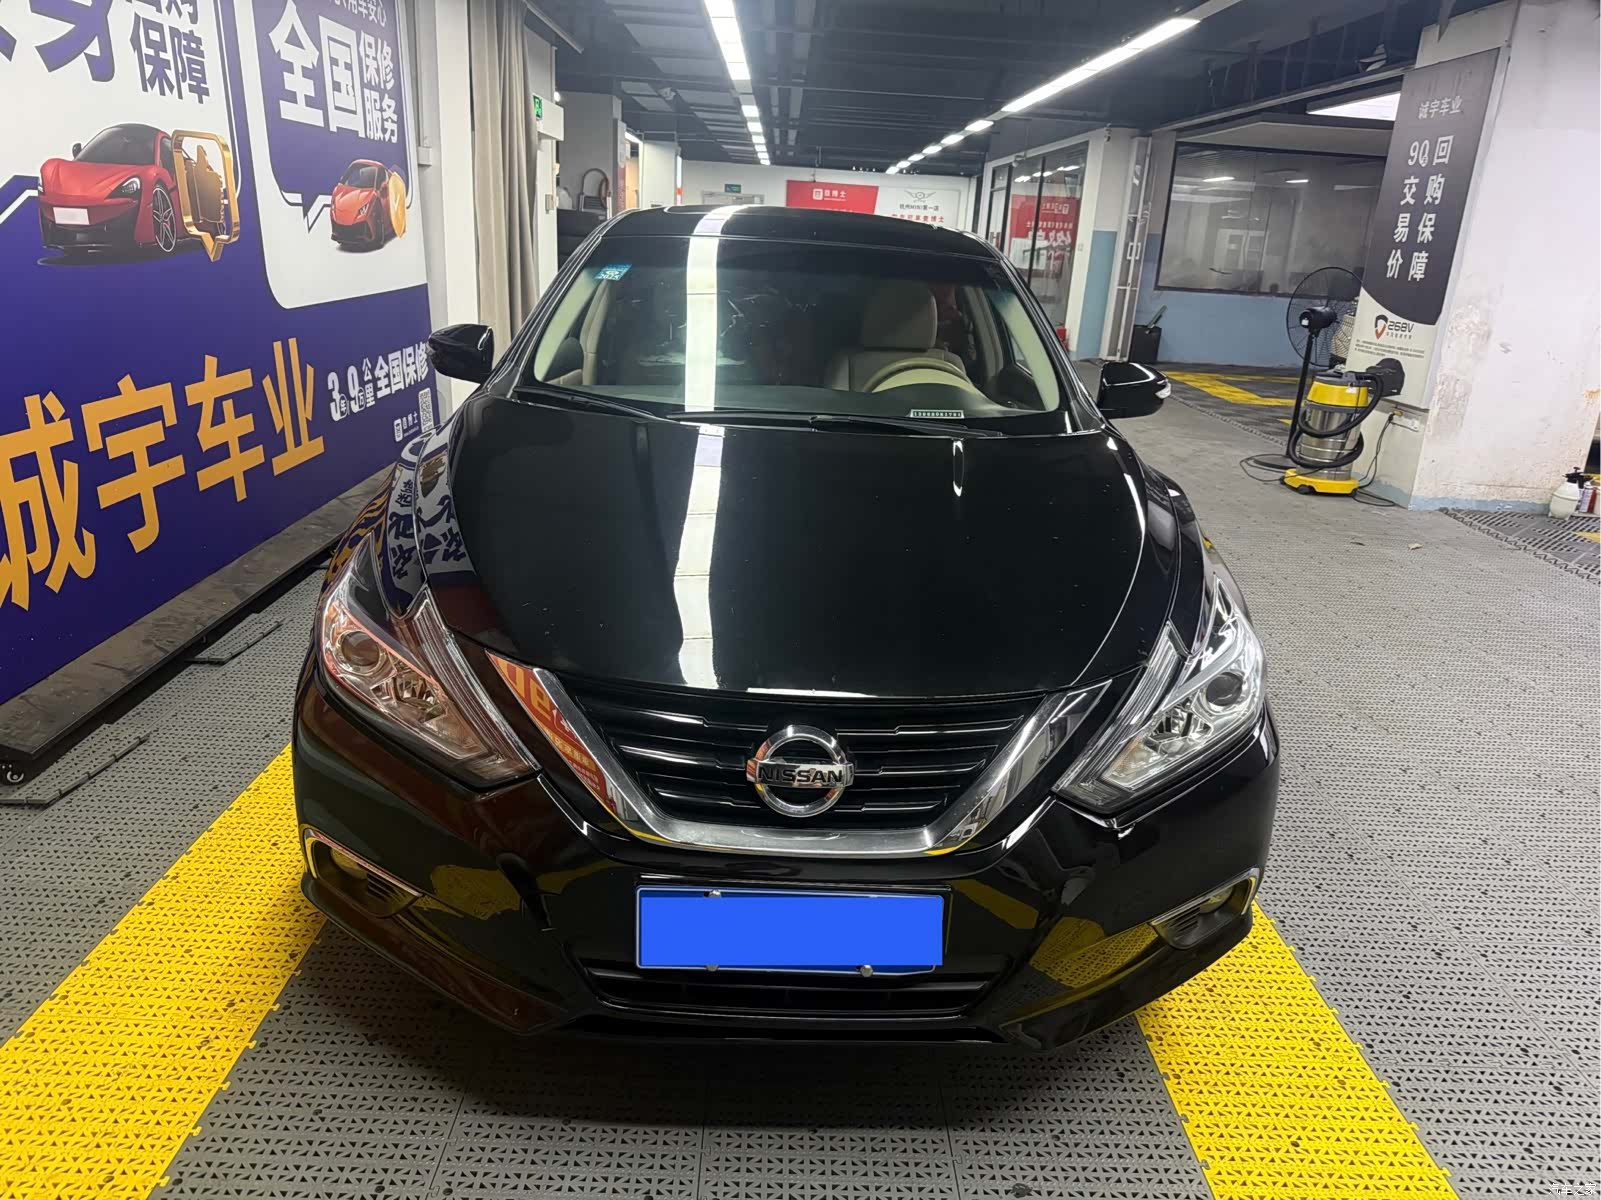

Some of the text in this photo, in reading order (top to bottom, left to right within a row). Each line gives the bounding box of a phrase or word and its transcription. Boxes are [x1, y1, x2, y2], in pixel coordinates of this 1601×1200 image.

[129, 11, 210, 104] 保障
[268, 0, 365, 138] 全国
[359, 30, 395, 90] 保修
[363, 87, 398, 143] 服务
[1418, 96, 1463, 119] 诚宇车业
[1388, 320, 1415, 333] 268V
[758, 766, 843, 783] NISSAN
